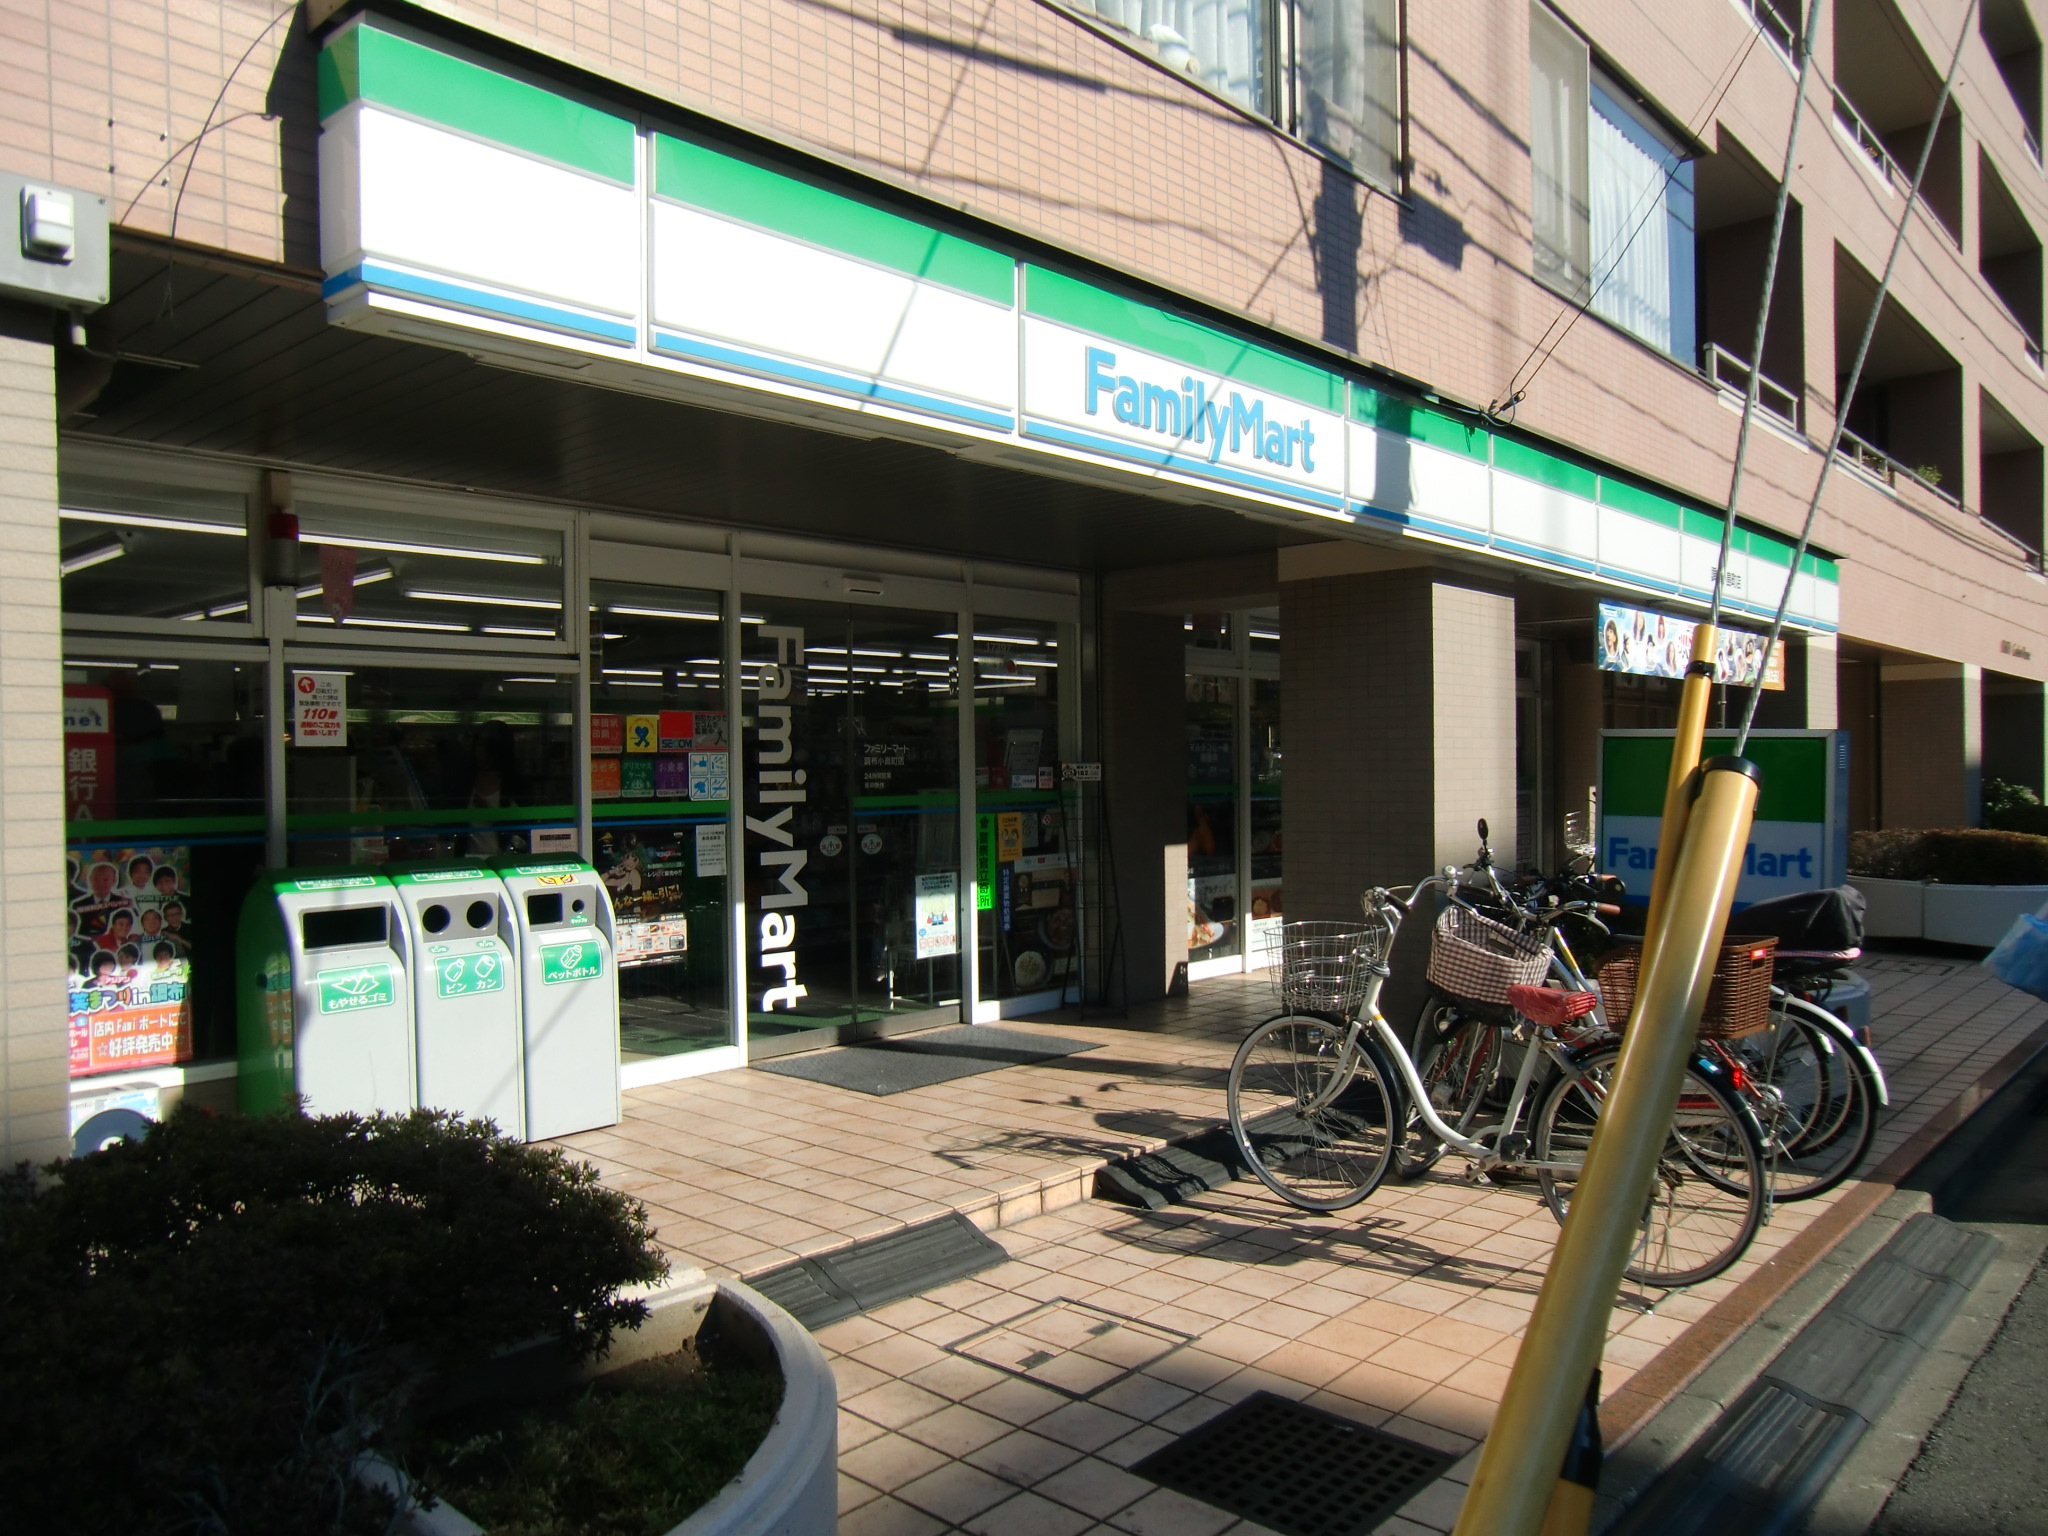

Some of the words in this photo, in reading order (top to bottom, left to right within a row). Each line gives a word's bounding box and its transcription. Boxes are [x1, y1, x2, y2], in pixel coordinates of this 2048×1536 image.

[1085, 345, 1315, 474] FamilyMart
[303, 708, 338, 720] 110番
[864, 744, 910, 754] ファミリーマート
[745, 625, 809, 1012] FamilyMart
[548, 967, 598, 979] ペットボトル
[446, 983, 467, 994] ビン
[476, 979, 497, 990] カン
[328, 992, 388, 1009] もやせるゴミ
[109, 1032, 173, 1058] 好評発売中
